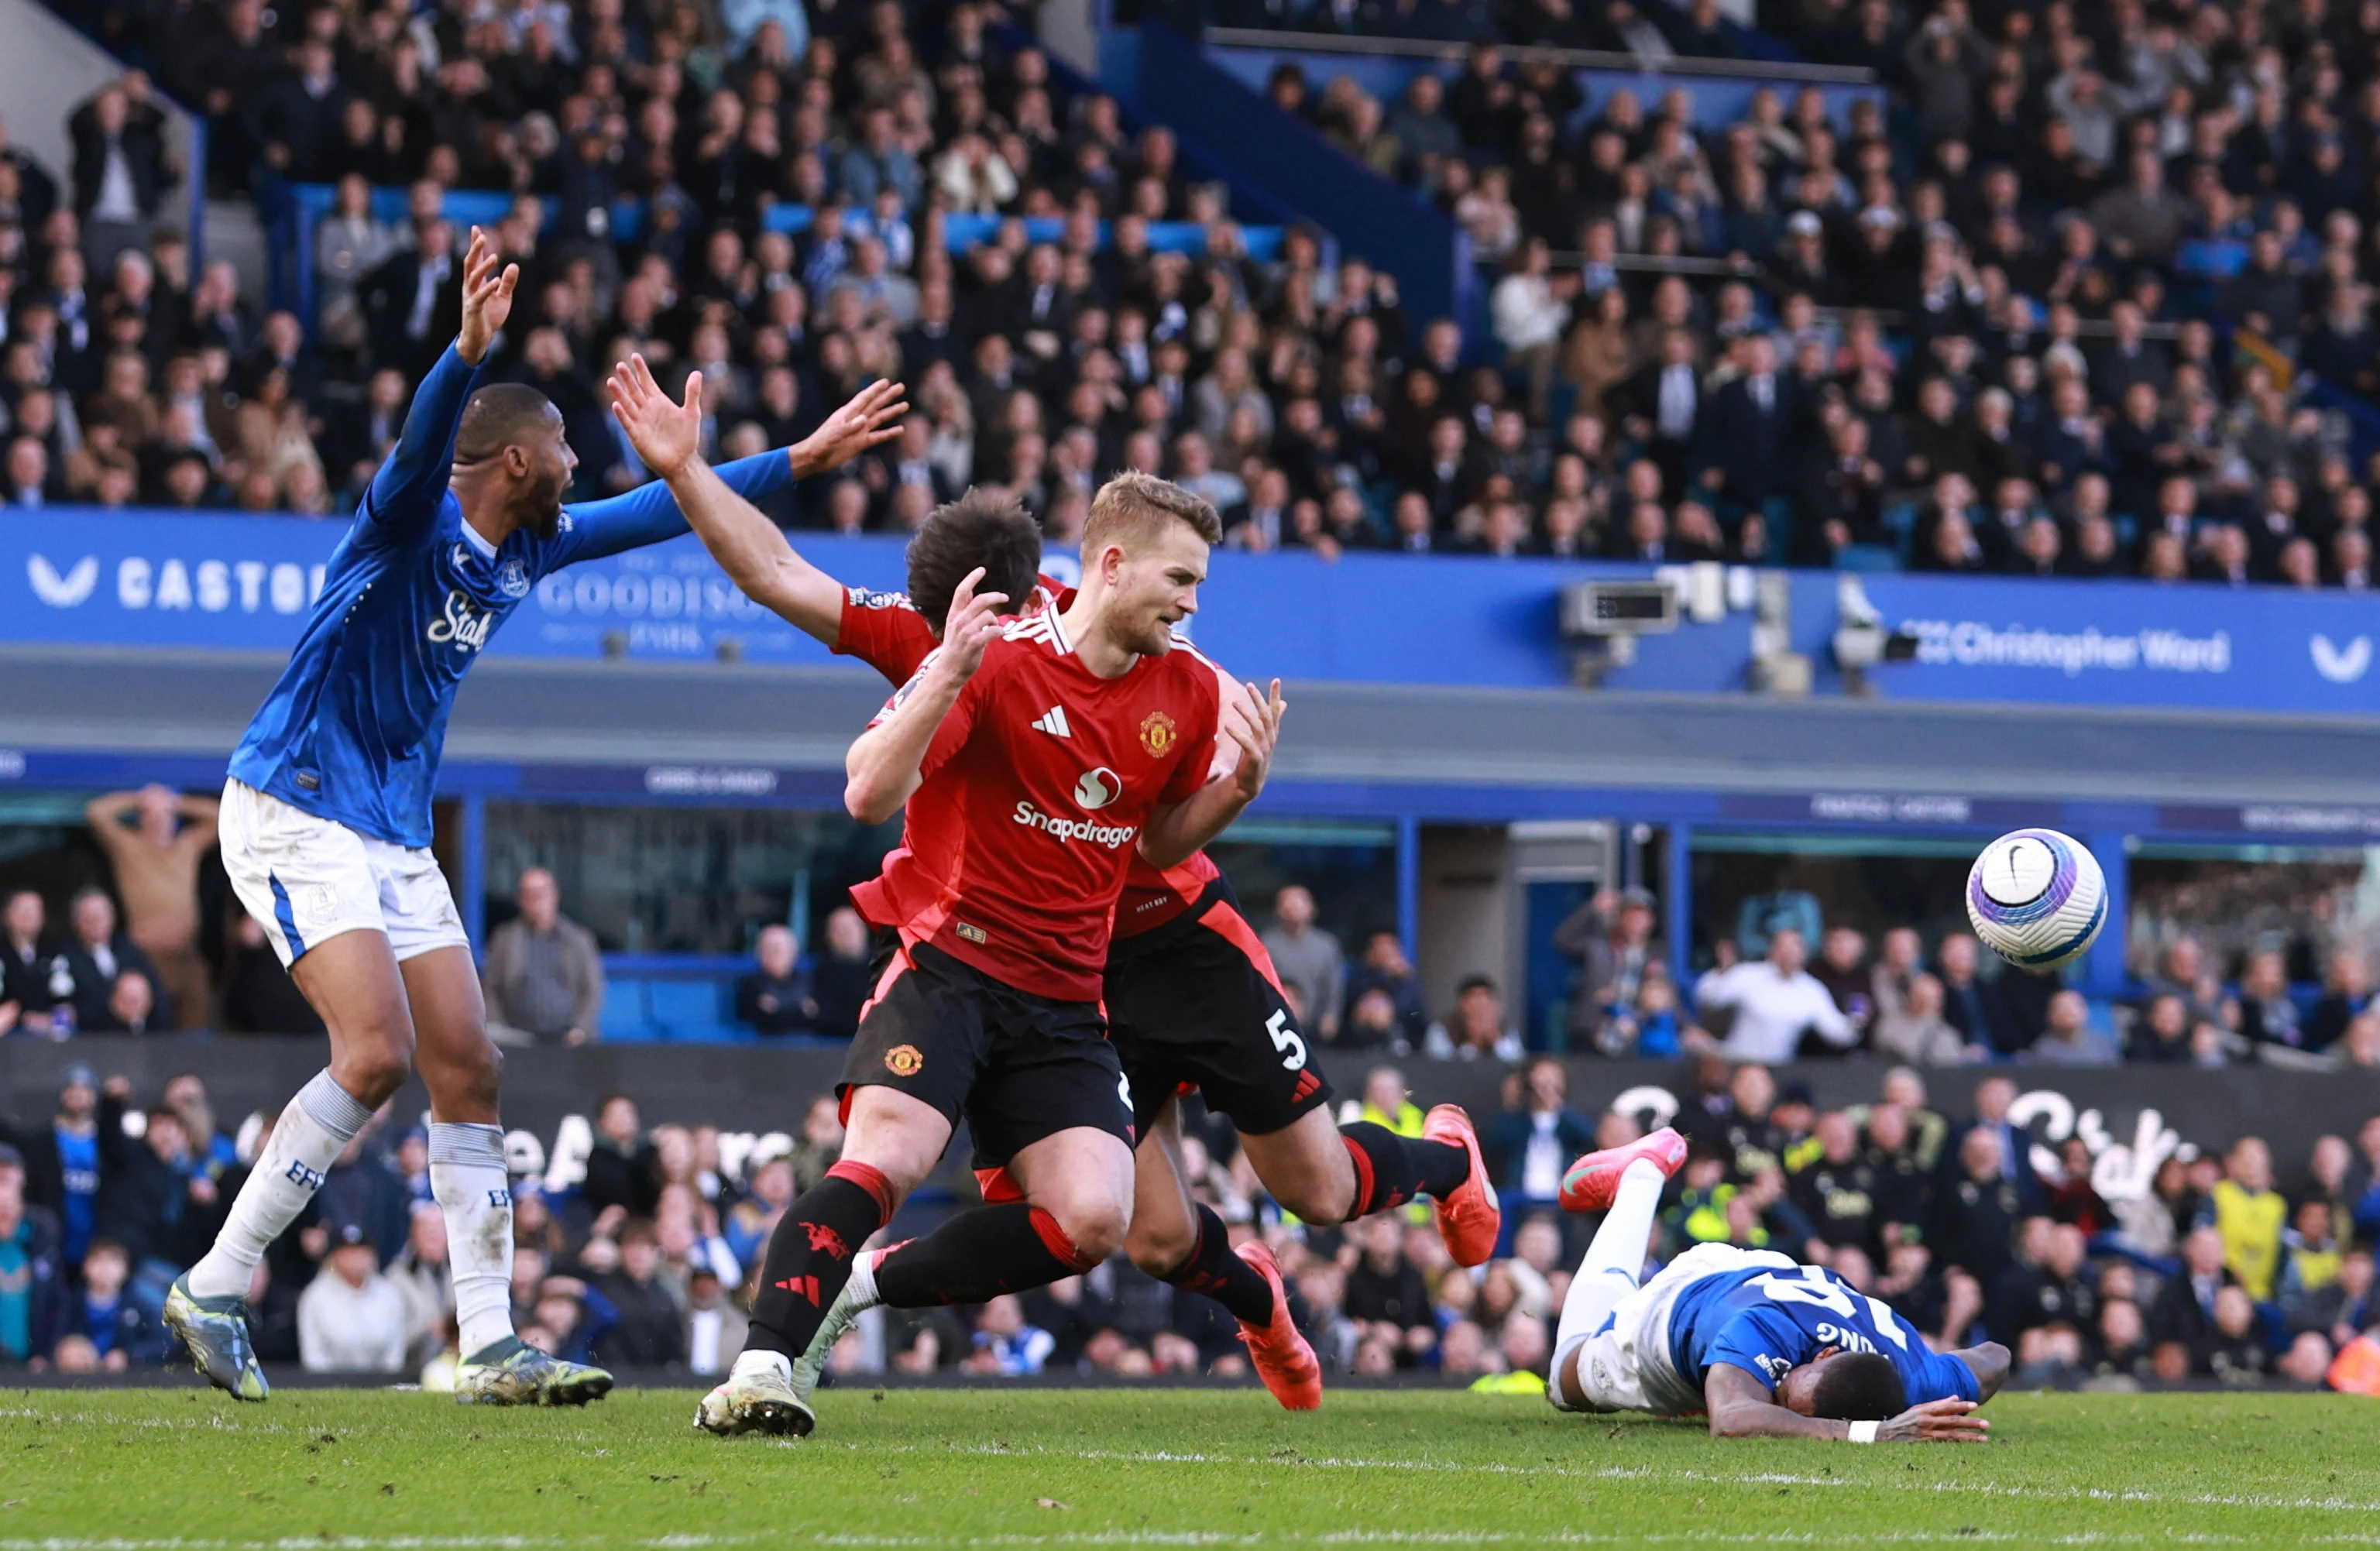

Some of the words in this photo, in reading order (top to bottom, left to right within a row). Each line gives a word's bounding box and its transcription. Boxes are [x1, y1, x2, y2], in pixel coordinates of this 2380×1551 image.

[428, 589, 493, 652] Stak
[537, 571, 781, 623] GOODISO
[1949, 620, 2138, 678] Christopher
[2137, 626, 2231, 674] Ward
[1012, 800, 1138, 849] Snapdrago
[1265, 1007, 1307, 1072] 5
